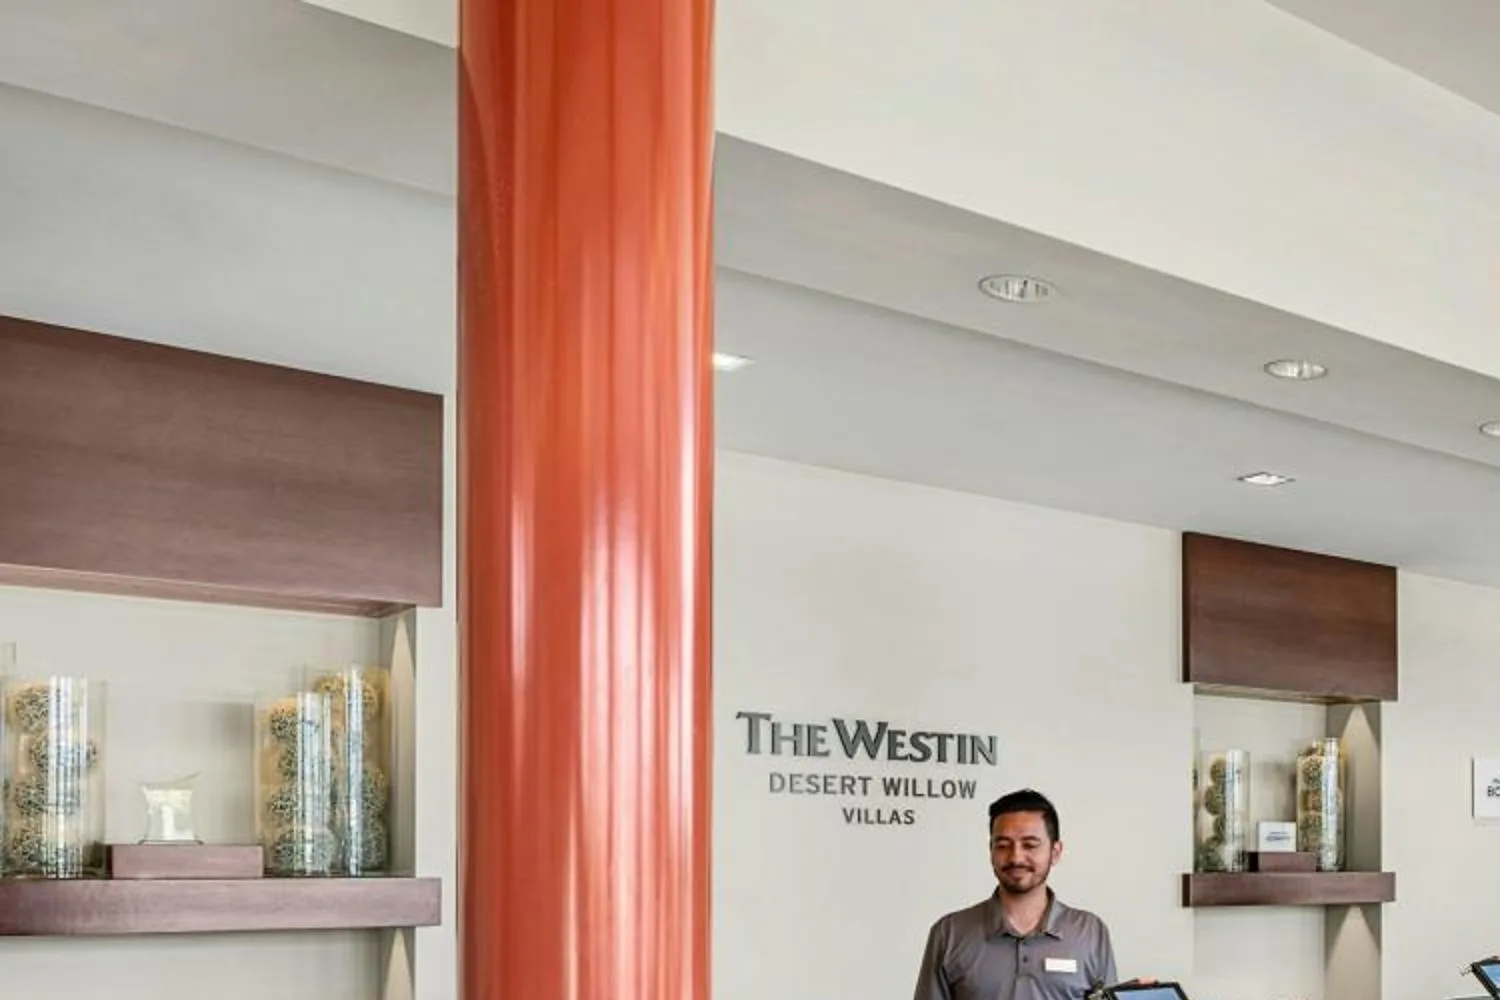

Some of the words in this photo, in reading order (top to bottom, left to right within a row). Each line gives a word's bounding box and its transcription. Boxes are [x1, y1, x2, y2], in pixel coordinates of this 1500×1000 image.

[736, 711, 831, 757] THE
[832, 718, 998, 765] WESTIN
[769, 772, 872, 796] DESERT
[882, 777, 977, 799] WILLOW
[842, 807, 915, 825] VILLAS
